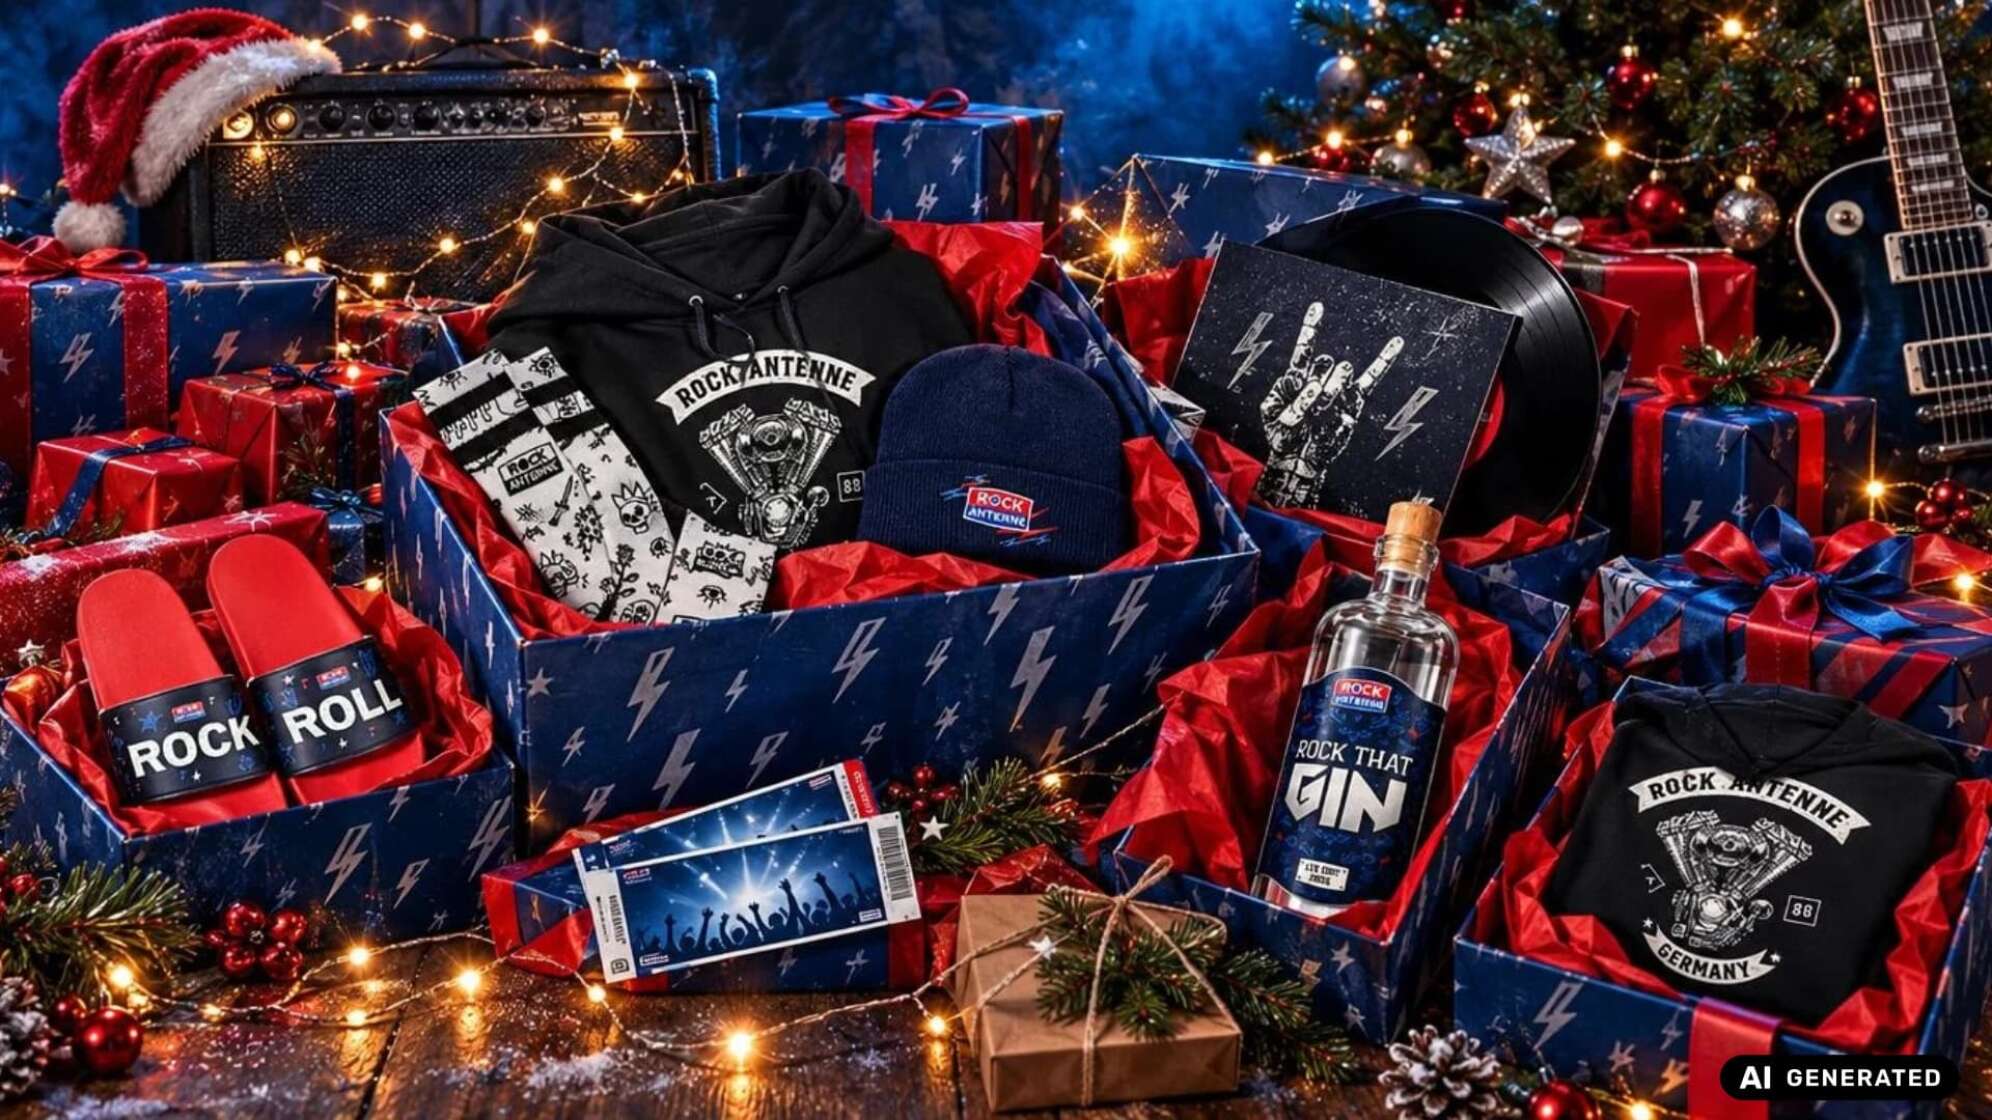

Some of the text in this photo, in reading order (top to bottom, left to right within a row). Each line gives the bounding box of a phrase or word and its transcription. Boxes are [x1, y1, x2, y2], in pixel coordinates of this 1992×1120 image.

[674, 355, 857, 409] ROCK ANTENNE
[506, 447, 550, 476] ROCK
[843, 478, 862, 494] 88
[976, 491, 1025, 513] ROCK
[1340, 682, 1384, 699] ROCK
[282, 678, 403, 744] ROLL
[127, 714, 261, 779] ROCK
[1295, 739, 1414, 777] ROCK THAT
[1284, 762, 1408, 834] GIN
[1648, 771, 1851, 830] ROCK ANTENNE
[1791, 902, 1813, 919] 88
[1656, 942, 1751, 981] GERMANY
